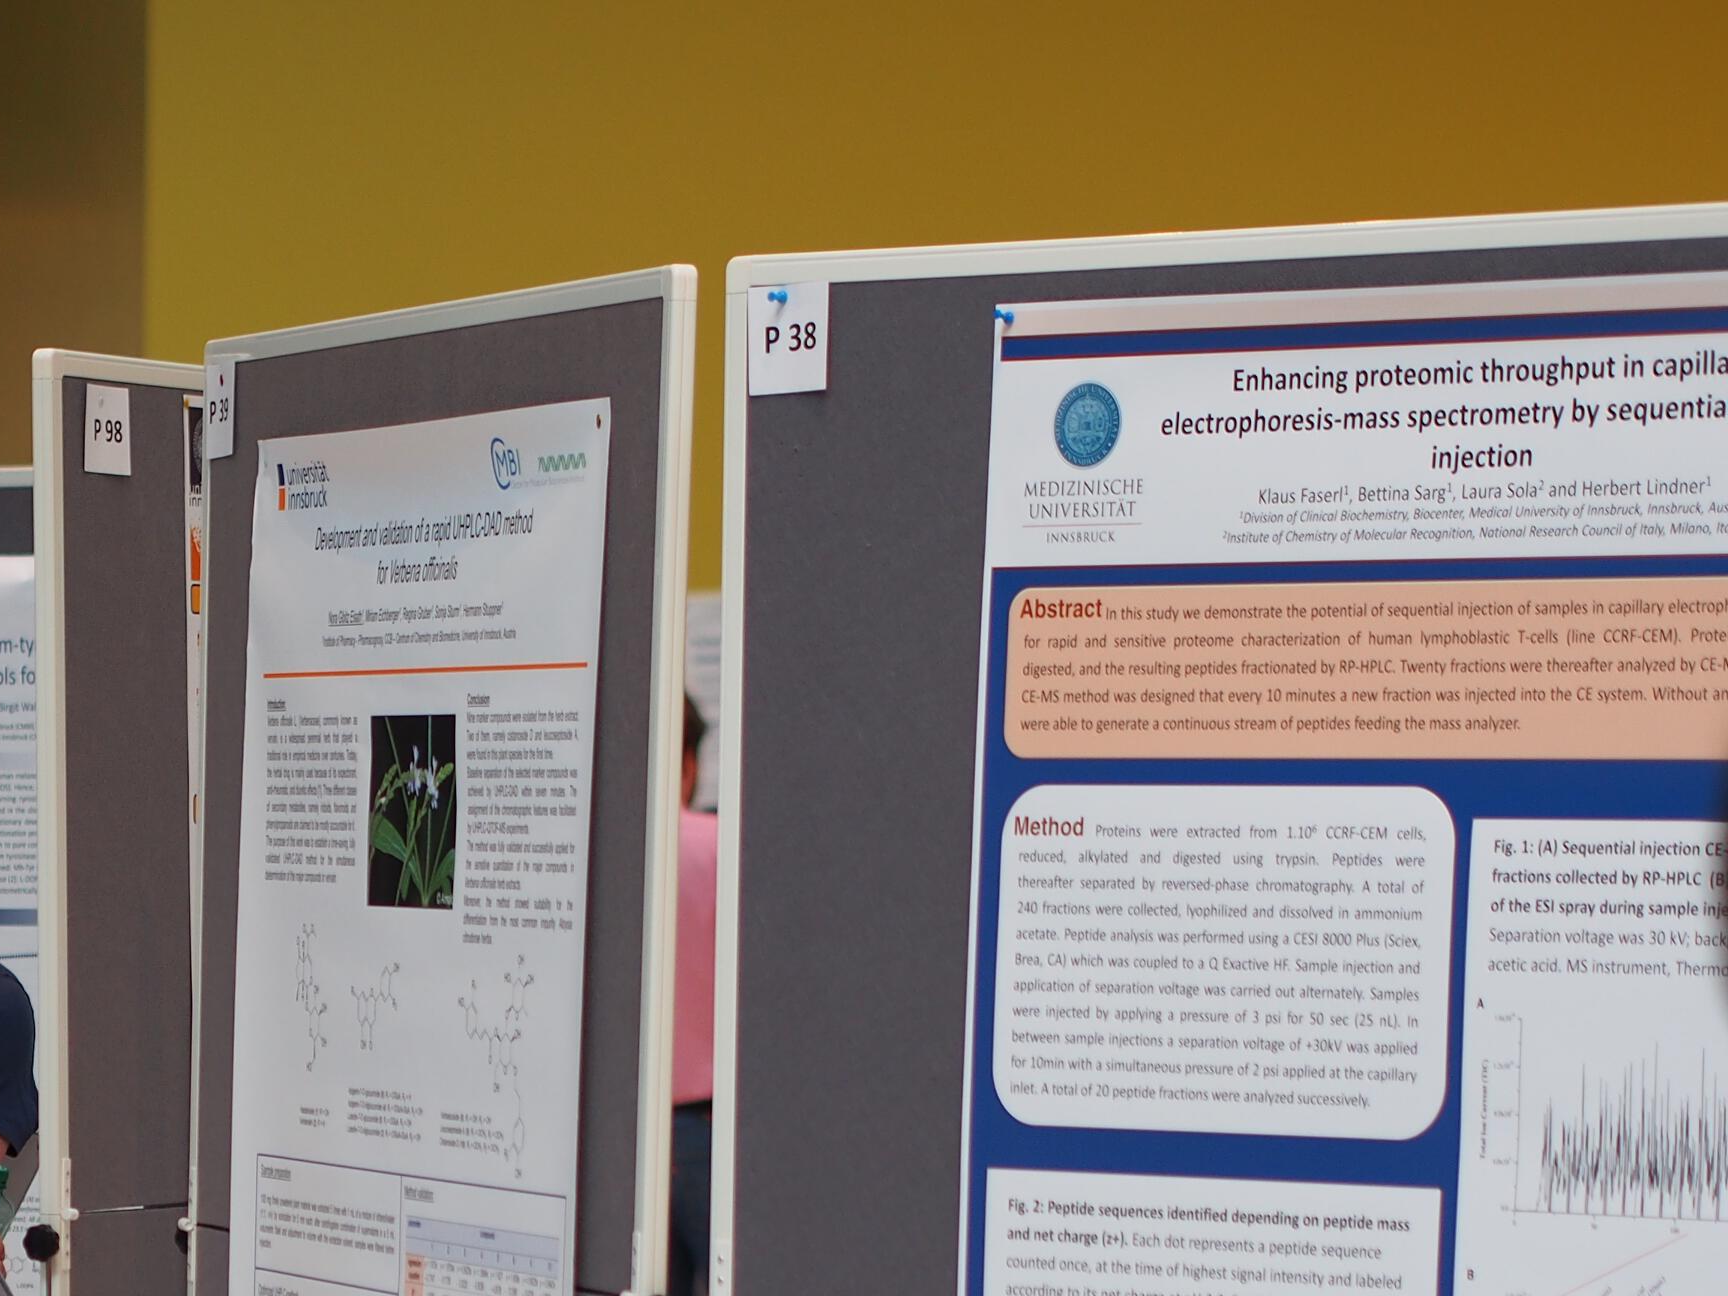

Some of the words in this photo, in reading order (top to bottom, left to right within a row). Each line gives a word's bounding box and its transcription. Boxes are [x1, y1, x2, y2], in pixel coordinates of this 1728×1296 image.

[765, 326, 780, 353] P
[788, 321, 817, 351] 38
[1233, 364, 1347, 397] Enhancing
[1355, 359, 1472, 392] proteomic
[1480, 354, 1615, 388] throughput
[1623, 353, 1643, 377] in
[210, 401, 217, 424] P
[219, 397, 229, 421] 39
[1161, 404, 1399, 440] electrophoresis-mass
[1407, 402, 1563, 433] spectrometry
[1571, 397, 1599, 428] by
[1606, 394, 1725, 427] sequentia
[94, 419, 101, 441] P
[105, 420, 123, 443] 98
[1432, 443, 1532, 474] injection
[286, 461, 330, 485] universität
[288, 487, 328, 511] innsbruck
[1024, 478, 1144, 498] MEDIZINISCHE
[1258, 488, 1295, 504] Klaus
[1358, 485, 1409, 502] Bettina
[1462, 483, 1501, 499] Laura
[1548, 480, 1576, 497] and
[1582, 479, 1641, 496] Herbert
[1029, 500, 1136, 519] UNIVERSITÄT
[1286, 510, 1298, 524] of
[1300, 510, 1337, 522] Clinical
[1340, 508, 1409, 522] Biochemistry,
[1413, 507, 1464, 520] Biocenter,
[1468, 506, 1512, 518] Medical
[1515, 505, 1570, 519] University
[1572, 503, 1585, 518] of
[1587, 503, 1642, 516] Innsbruck,
[1647, 502, 1703, 514] Innsbruck,
[315, 526, 361, 554] Development
[362, 522, 378, 547] and
[379, 519, 413, 546] validation
[415, 518, 425, 543] of
[431, 516, 451, 547] rapid
[453, 511, 502, 540] UHPLC-DAD
[503, 508, 534, 536] method
[1046, 531, 1116, 544] INNSBRUCK
[1271, 530, 1284, 544] of
[1285, 529, 1337, 544] Chemistry
[1339, 529, 1352, 543] of
[1353, 528, 1407, 540] Molecular
[1410, 527, 1474, 542] Recognition,
[1479, 526, 1526, 538] National
[1529, 524, 1578, 537] Research
[1581, 523, 1622, 536] Council
[1624, 522, 1637, 538] of
[1639, 523, 1665, 537] Italy,
[1669, 522, 1711, 535] Milano,
[377, 560, 389, 584] for
[389, 559, 421, 583] Verbena
[1020, 598, 1101, 618] Abstract
[1106, 607, 1116, 620] In
[1120, 606, 1142, 620] this
[1145, 605, 1179, 622] study
[1182, 608, 1200, 619] we
[1204, 604, 1282, 619] demonstrate
[1286, 604, 1306, 618] the
[1311, 603, 1367, 620] potential
[1371, 602, 1384, 617] of
[1387, 602, 1453, 619] sequential
[1457, 601, 1513, 619] injection
[1517, 600, 1531, 615] of
[1534, 600, 1588, 617] samples
[1592, 600, 1604, 614] in
[1607, 599, 1664, 616] capillary
[1024, 634, 1040, 648] for
[1047, 634, 1077, 650] rapid
[1084, 634, 1106, 648] and
[1114, 634, 1166, 648] sensitive
[1173, 635, 1234, 649] proteome
[1241, 631, 1340, 646] characterization
[1347, 630, 1361, 645] of
[1368, 631, 1412, 645] human
[1420, 629, 1509, 647] lymphoblastic
[1517, 629, 1558, 644] T-cells
[1566, 629, 1595, 646] (line
[1014, 816, 1083, 835] Method
[1095, 824, 1141, 837] Proteins
[1149, 828, 1178, 837] were
[1186, 825, 1240, 838] extracted
[1249, 825, 1277, 838] from
[1325, 826, 1387, 839] CCRF-CEM
[1494, 839, 1516, 856] Fig.
[1538, 839, 1557, 856] (A)
[1562, 840, 1635, 857] Sequential
[1640, 841, 1700, 858] injection
[1008, 1198, 1028, 1215] Fig.
[1033, 1199, 1043, 1213] 2:
[1048, 1200, 1094, 1217] Peptide
[1098, 1206, 1163, 1221] sequences
[1167, 1206, 1227, 1222] identified
[1231, 1209, 1299, 1229] depending
[1303, 1216, 1318, 1226] on
[1323, 1214, 1373, 1232] peptide
[1377, 1219, 1409, 1231] mass
